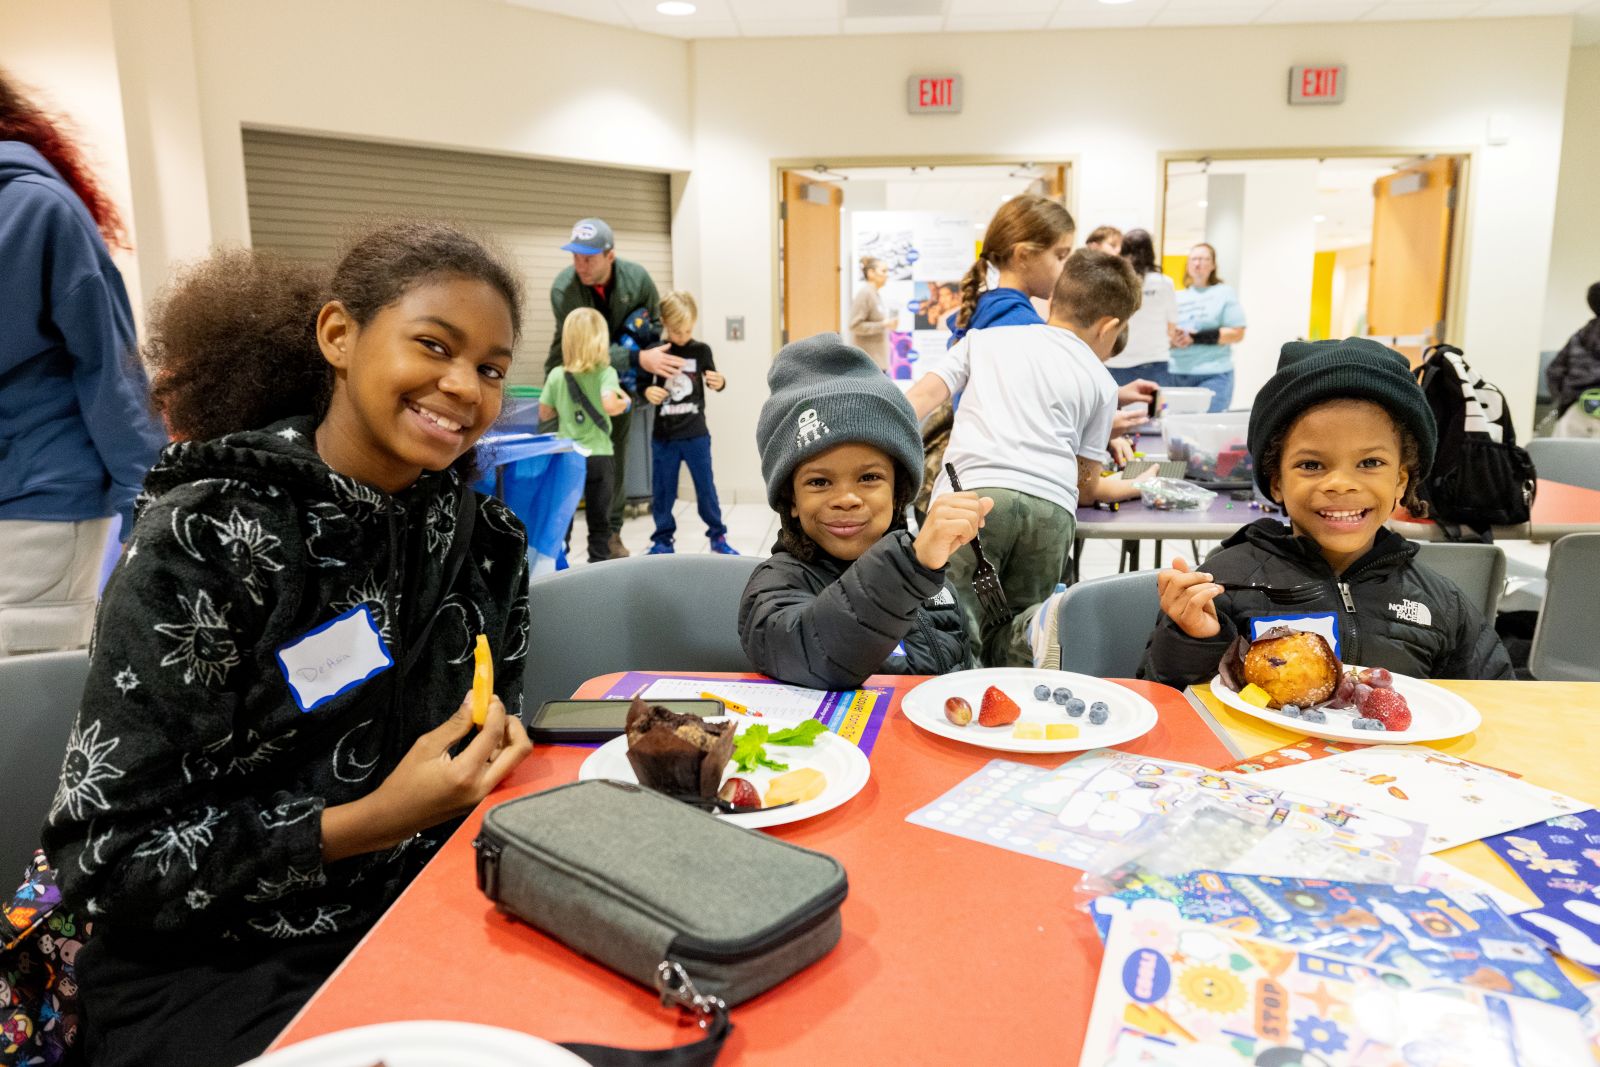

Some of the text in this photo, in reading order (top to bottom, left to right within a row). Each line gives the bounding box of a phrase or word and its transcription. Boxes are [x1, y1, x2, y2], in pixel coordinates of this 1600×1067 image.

[919, 78, 954, 107] EXIT
[1302, 67, 1338, 97] EXIT
[1388, 602, 1418, 615] NORTH
[1402, 598, 1418, 608] THE
[1396, 610, 1417, 622] FACE
[1262, 983, 1281, 1037] STOP
